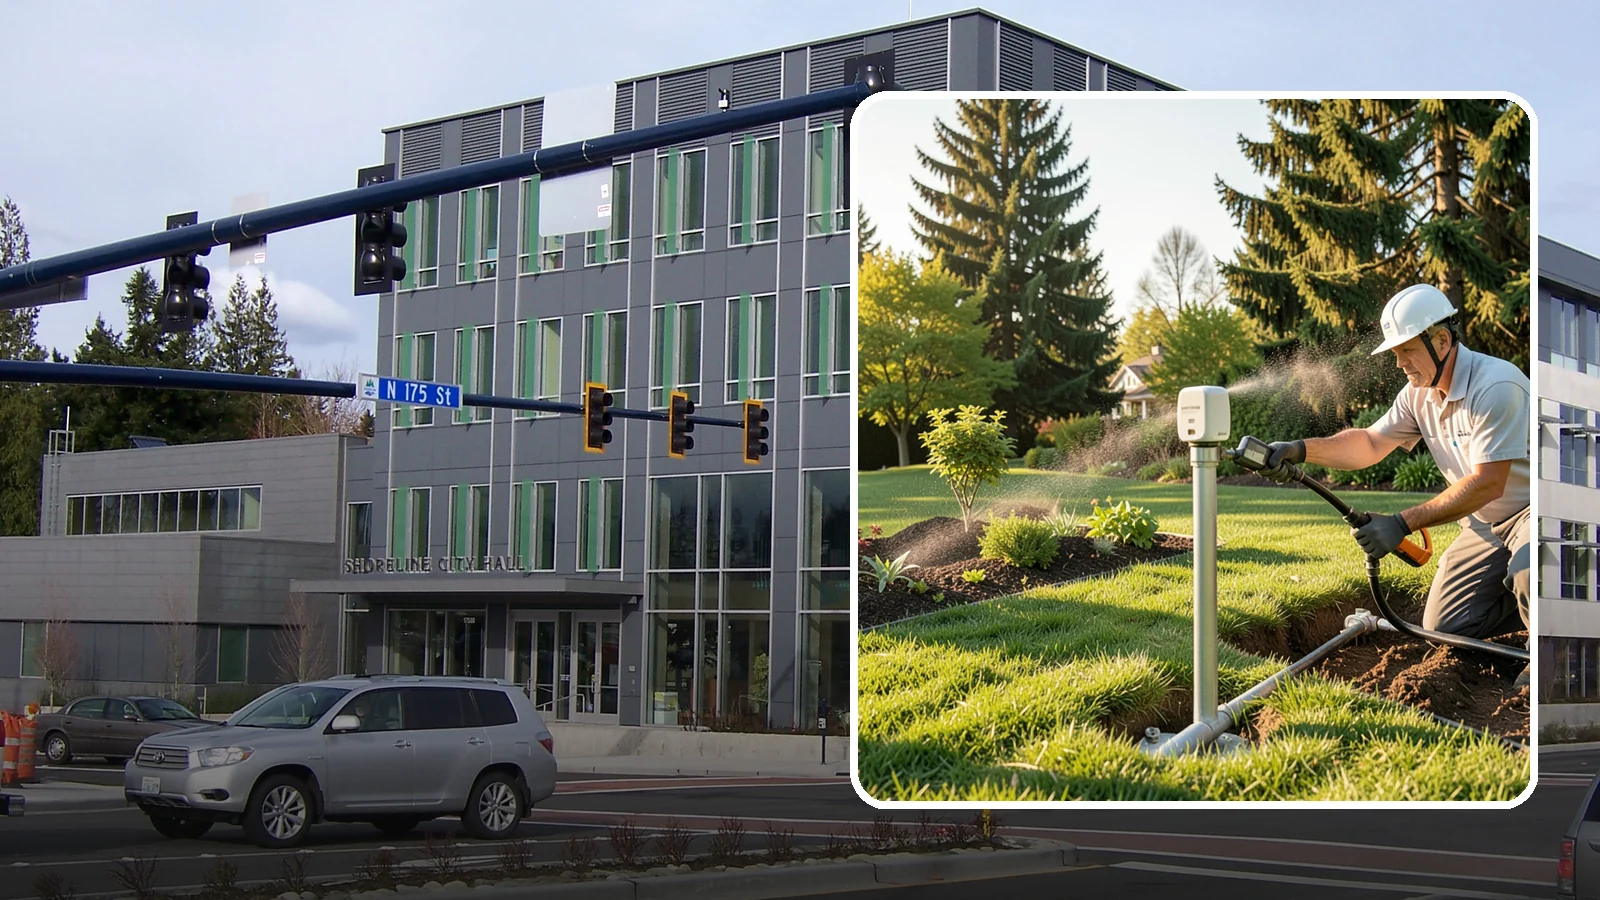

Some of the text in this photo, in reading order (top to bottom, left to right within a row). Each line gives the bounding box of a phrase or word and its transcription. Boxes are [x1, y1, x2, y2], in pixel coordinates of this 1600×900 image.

[387, 380, 452, 406] N 175 St
[343, 554, 525, 574] SHORELINE CITY HALL
